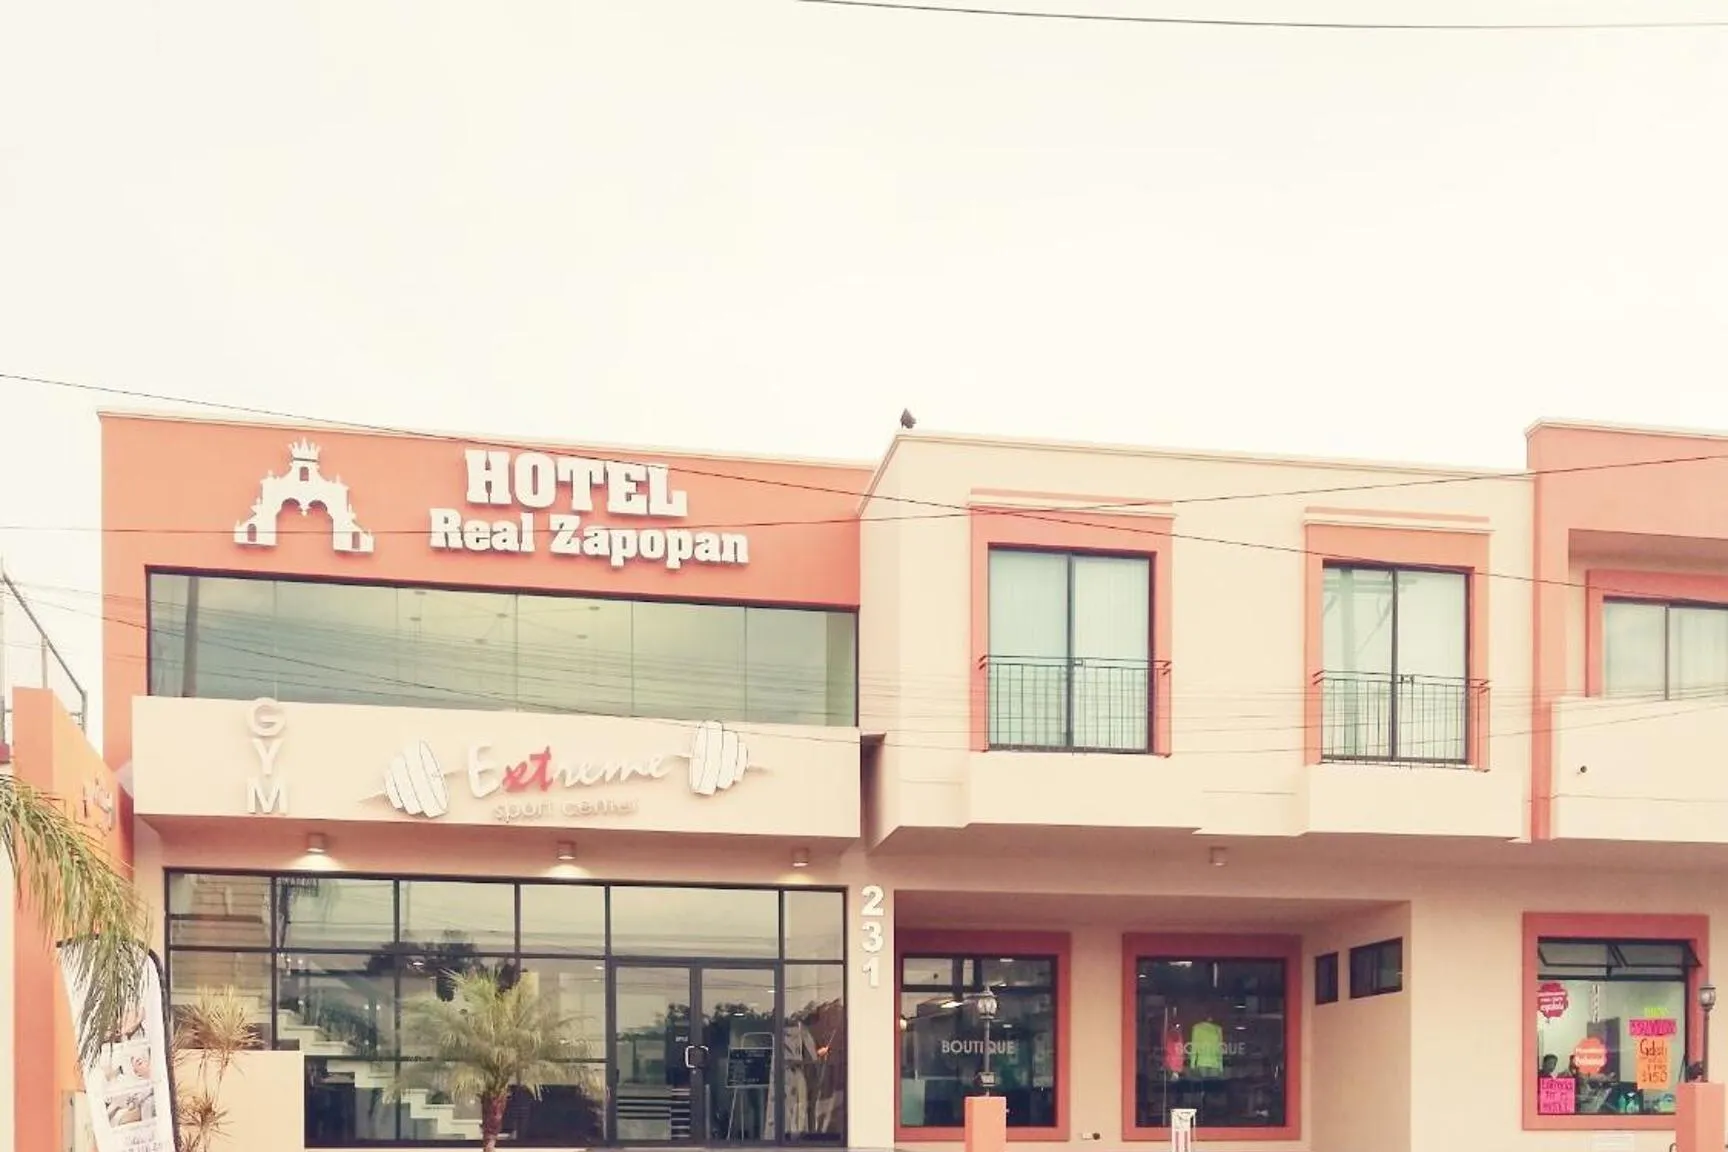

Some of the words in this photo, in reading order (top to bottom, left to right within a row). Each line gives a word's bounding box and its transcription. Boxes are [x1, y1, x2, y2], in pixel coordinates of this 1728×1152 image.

[465, 449, 688, 517] HOTEL
[430, 508, 535, 553] Real
[549, 513, 750, 570] Zapopan
[246, 697, 287, 815] GYM
[468, 746, 673, 799] Extreme
[861, 885, 884, 988] 231
[941, 1039, 1017, 1054] BOUTIQUE
[1175, 1041, 1247, 1055] BOQUE
